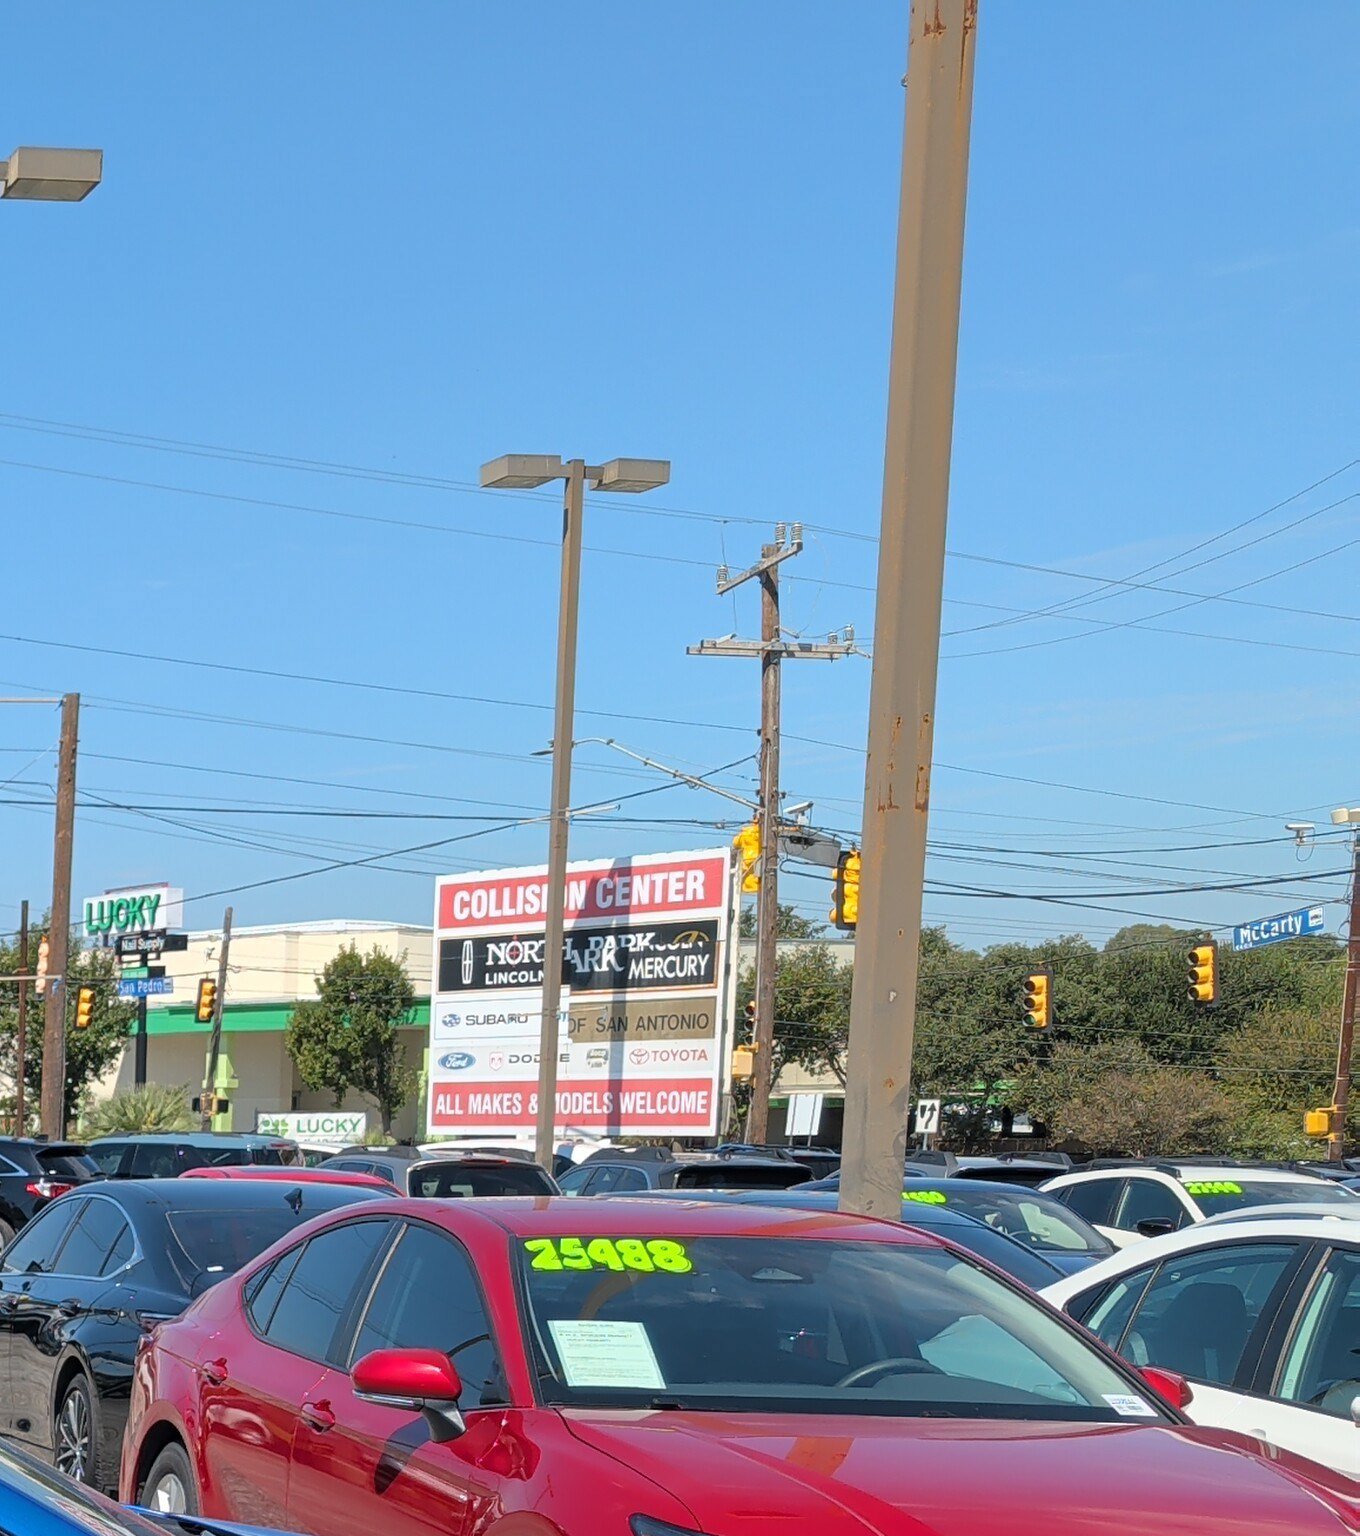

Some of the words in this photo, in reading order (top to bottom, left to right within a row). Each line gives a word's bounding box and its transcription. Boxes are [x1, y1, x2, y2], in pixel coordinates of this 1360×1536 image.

[453, 880, 587, 921] COLLISIN
[596, 869, 706, 909] CENTER
[86, 894, 162, 932] LUCKY
[1240, 915, 1302, 944] McCarty
[628, 954, 710, 980] MERCURY
[119, 981, 135, 995] San
[137, 979, 163, 994] Pedro
[466, 1013, 528, 1026] SUBARU
[596, 1016, 628, 1033] SAN
[635, 1013, 709, 1031] ANTONIO
[508, 1054, 570, 1064] DODE
[651, 1049, 709, 1063] TOYOTA
[435, 1093, 464, 1115] ALL
[467, 1093, 522, 1115] MAKES
[619, 1090, 709, 1114] WELCOME
[296, 1119, 362, 1133] LUCKY
